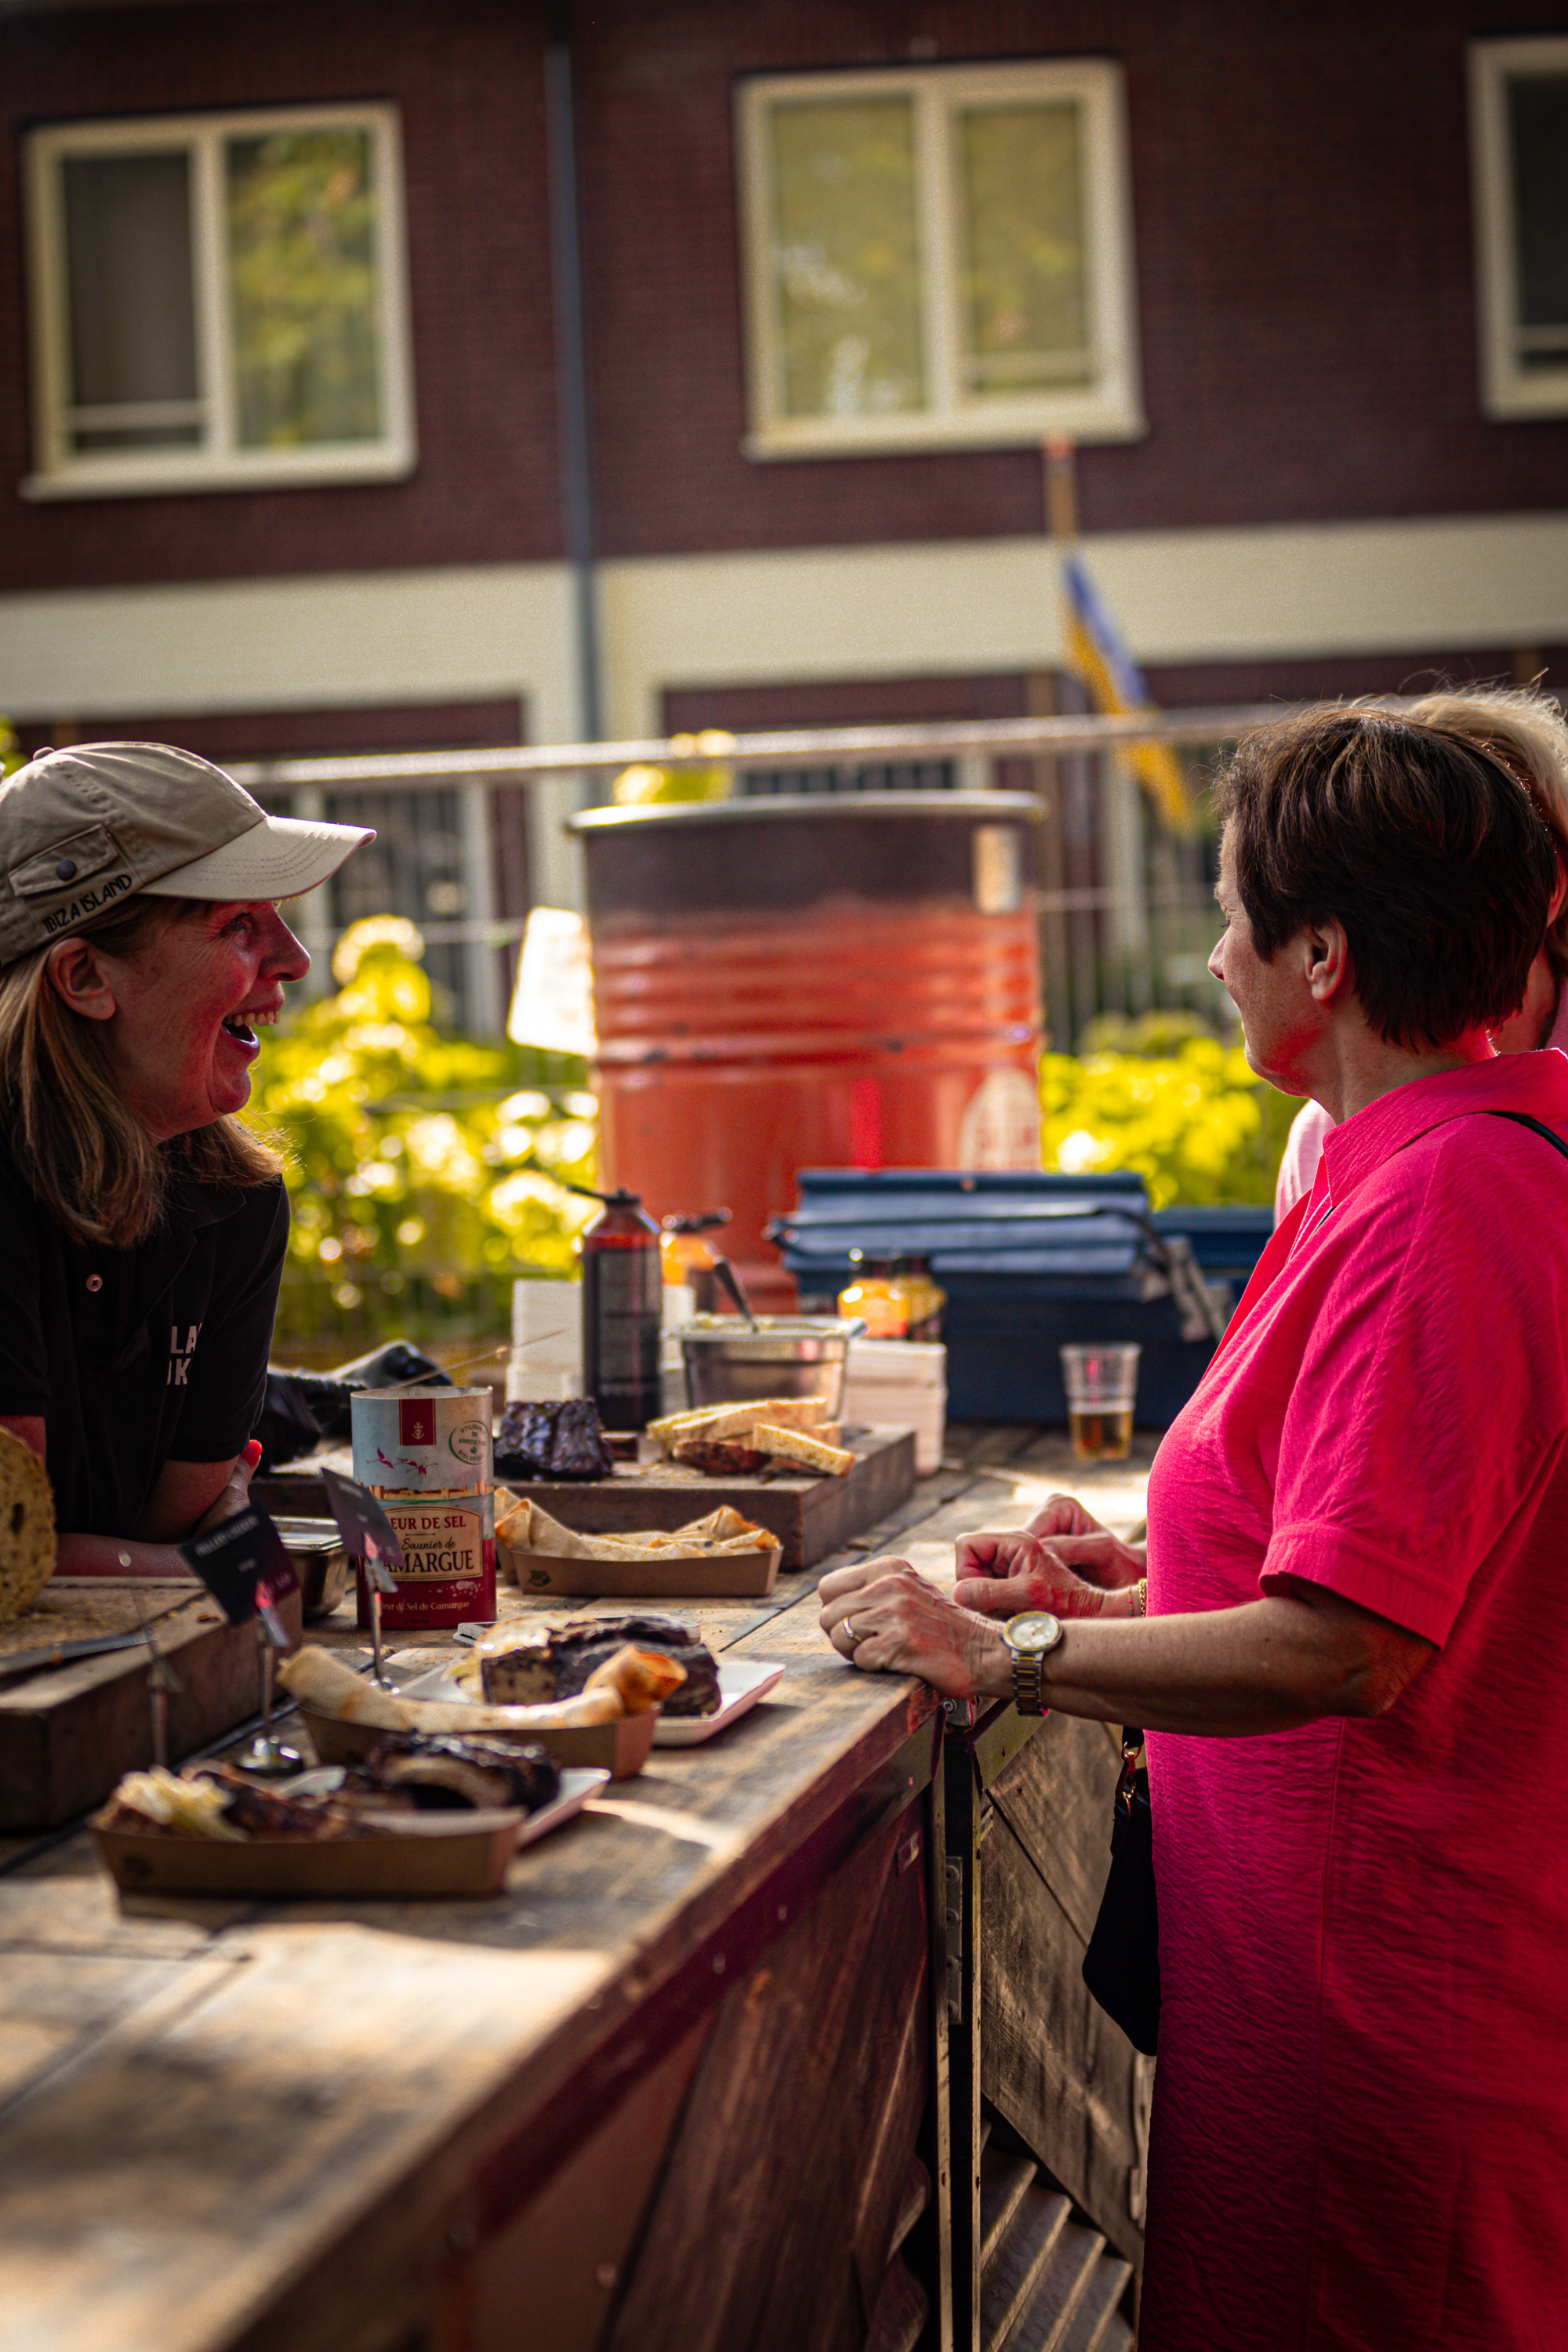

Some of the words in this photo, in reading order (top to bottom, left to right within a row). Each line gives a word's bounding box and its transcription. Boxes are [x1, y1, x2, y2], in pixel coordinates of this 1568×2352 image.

[42, 902, 81, 934] IBIZA
[79, 874, 132, 913] ISLAND
[170, 1322, 202, 1355] LA
[421, 1517, 441, 1530] DE
[444, 1515, 466, 1529] SEL
[401, 1537, 444, 1551] Saunier
[445, 1537, 456, 1550] de
[406, 1602, 418, 1610] Sel
[419, 1601, 429, 1610] de
[430, 1601, 470, 1611] Camargue
